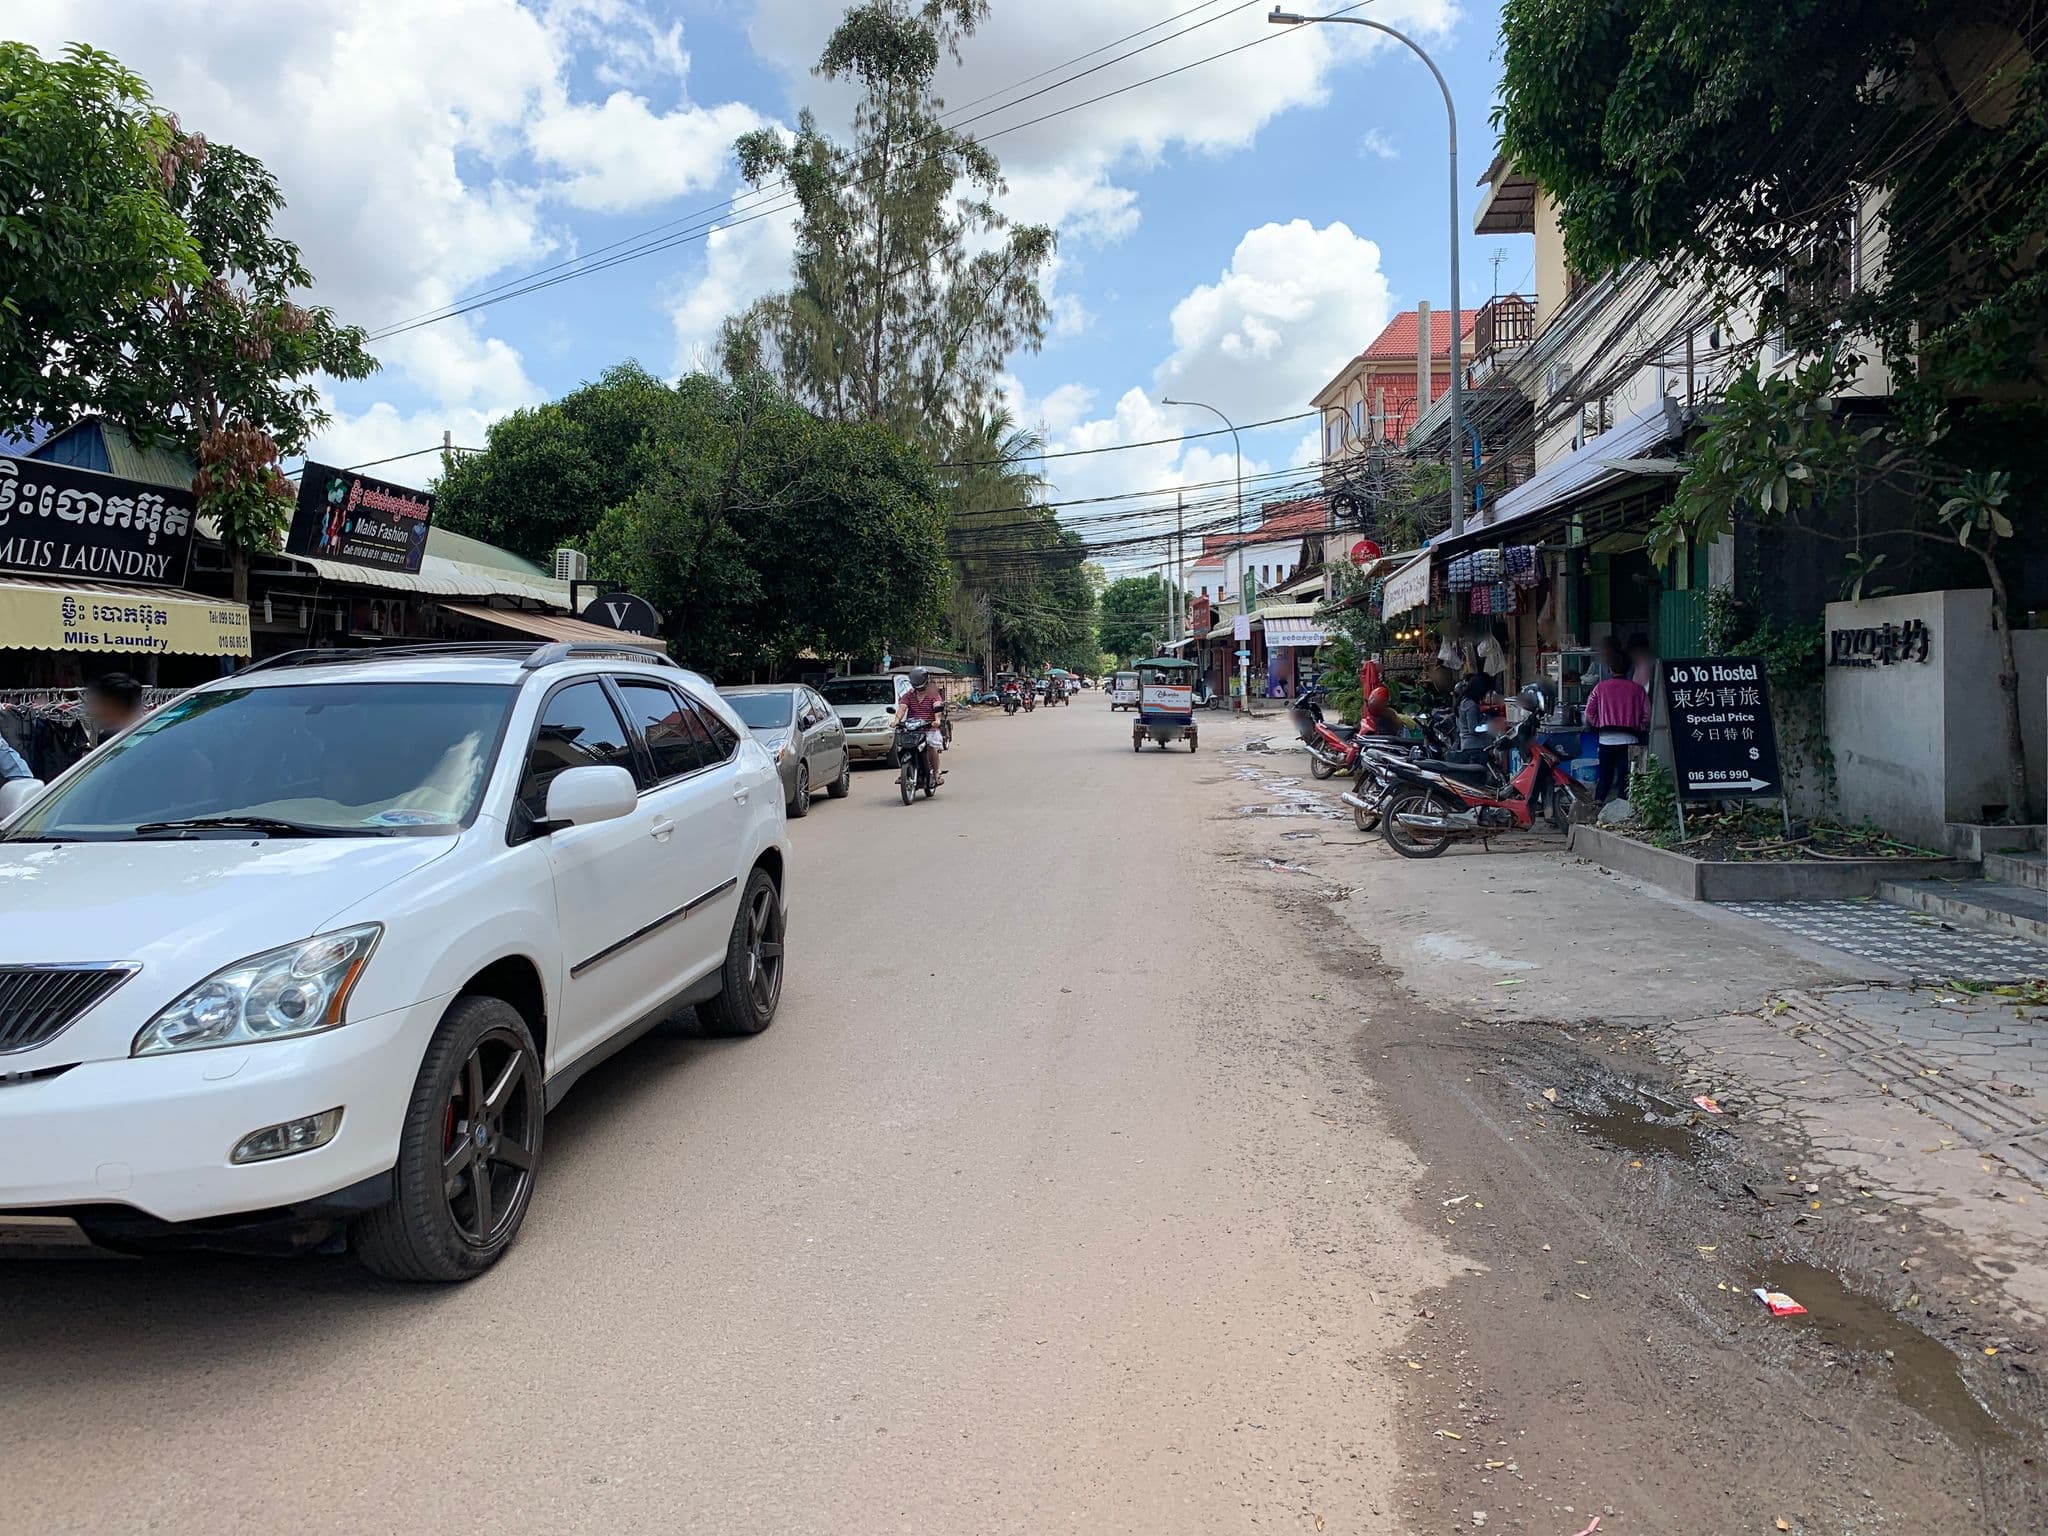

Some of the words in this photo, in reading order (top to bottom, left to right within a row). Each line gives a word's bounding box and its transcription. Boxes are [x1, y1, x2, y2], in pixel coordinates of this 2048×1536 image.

[354, 517, 378, 537] Malis
[377, 522, 408, 543] Fashion
[59, 544, 172, 578] LAUNDRY
[219, 611, 228, 625] 099
[235, 613, 241, 625] 22
[604, 602, 632, 629] V
[64, 632, 99, 644] Mlis
[104, 632, 168, 650] Laundry
[218, 635, 228, 648] 010
[1670, 666, 1688, 683] Jo
[1690, 666, 1709, 682] Yo
[1711, 664, 1758, 681] Hostel
[1686, 713, 1726, 725] Special
[1728, 712, 1755, 722] Price
[1691, 727, 1755, 742] 今日特价
[1749, 746, 1760, 760] $
[1688, 771, 1705, 780] 016
[1707, 770, 1727, 780] 366
[1729, 769, 1749, 779] 990
